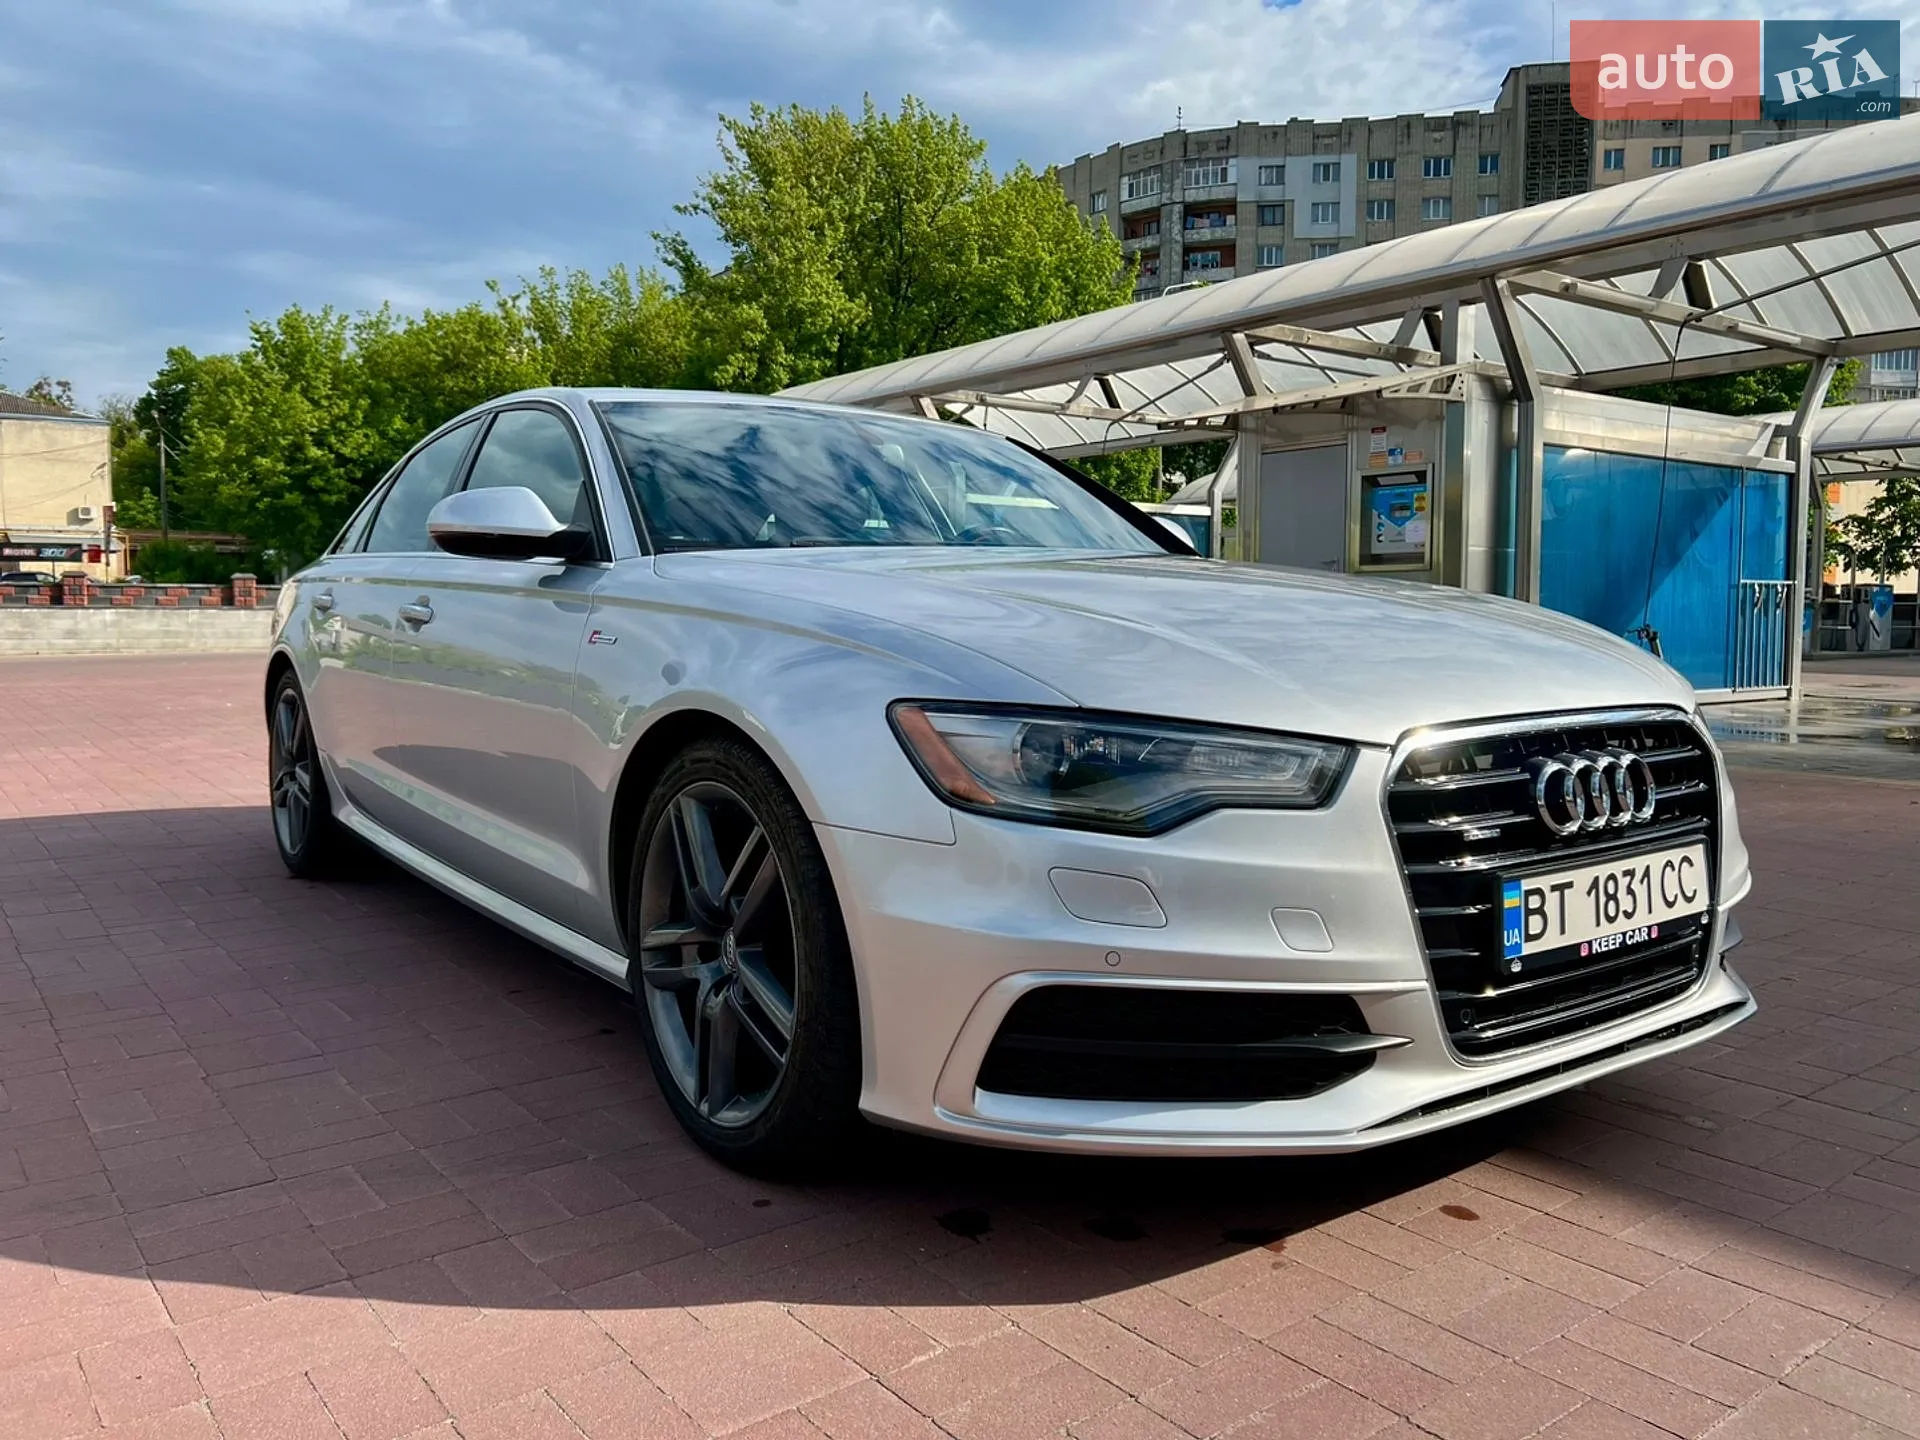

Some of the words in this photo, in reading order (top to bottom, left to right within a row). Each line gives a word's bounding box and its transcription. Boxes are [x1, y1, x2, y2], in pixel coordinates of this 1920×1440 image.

[1523, 880, 1574, 943] BT
[1586, 864, 1653, 928] 1831
[1660, 855, 1698, 909] CC
[1504, 928, 1521, 946] UA
[1591, 933, 1624, 955] KEEP
[1625, 927, 1649, 946] CAR
